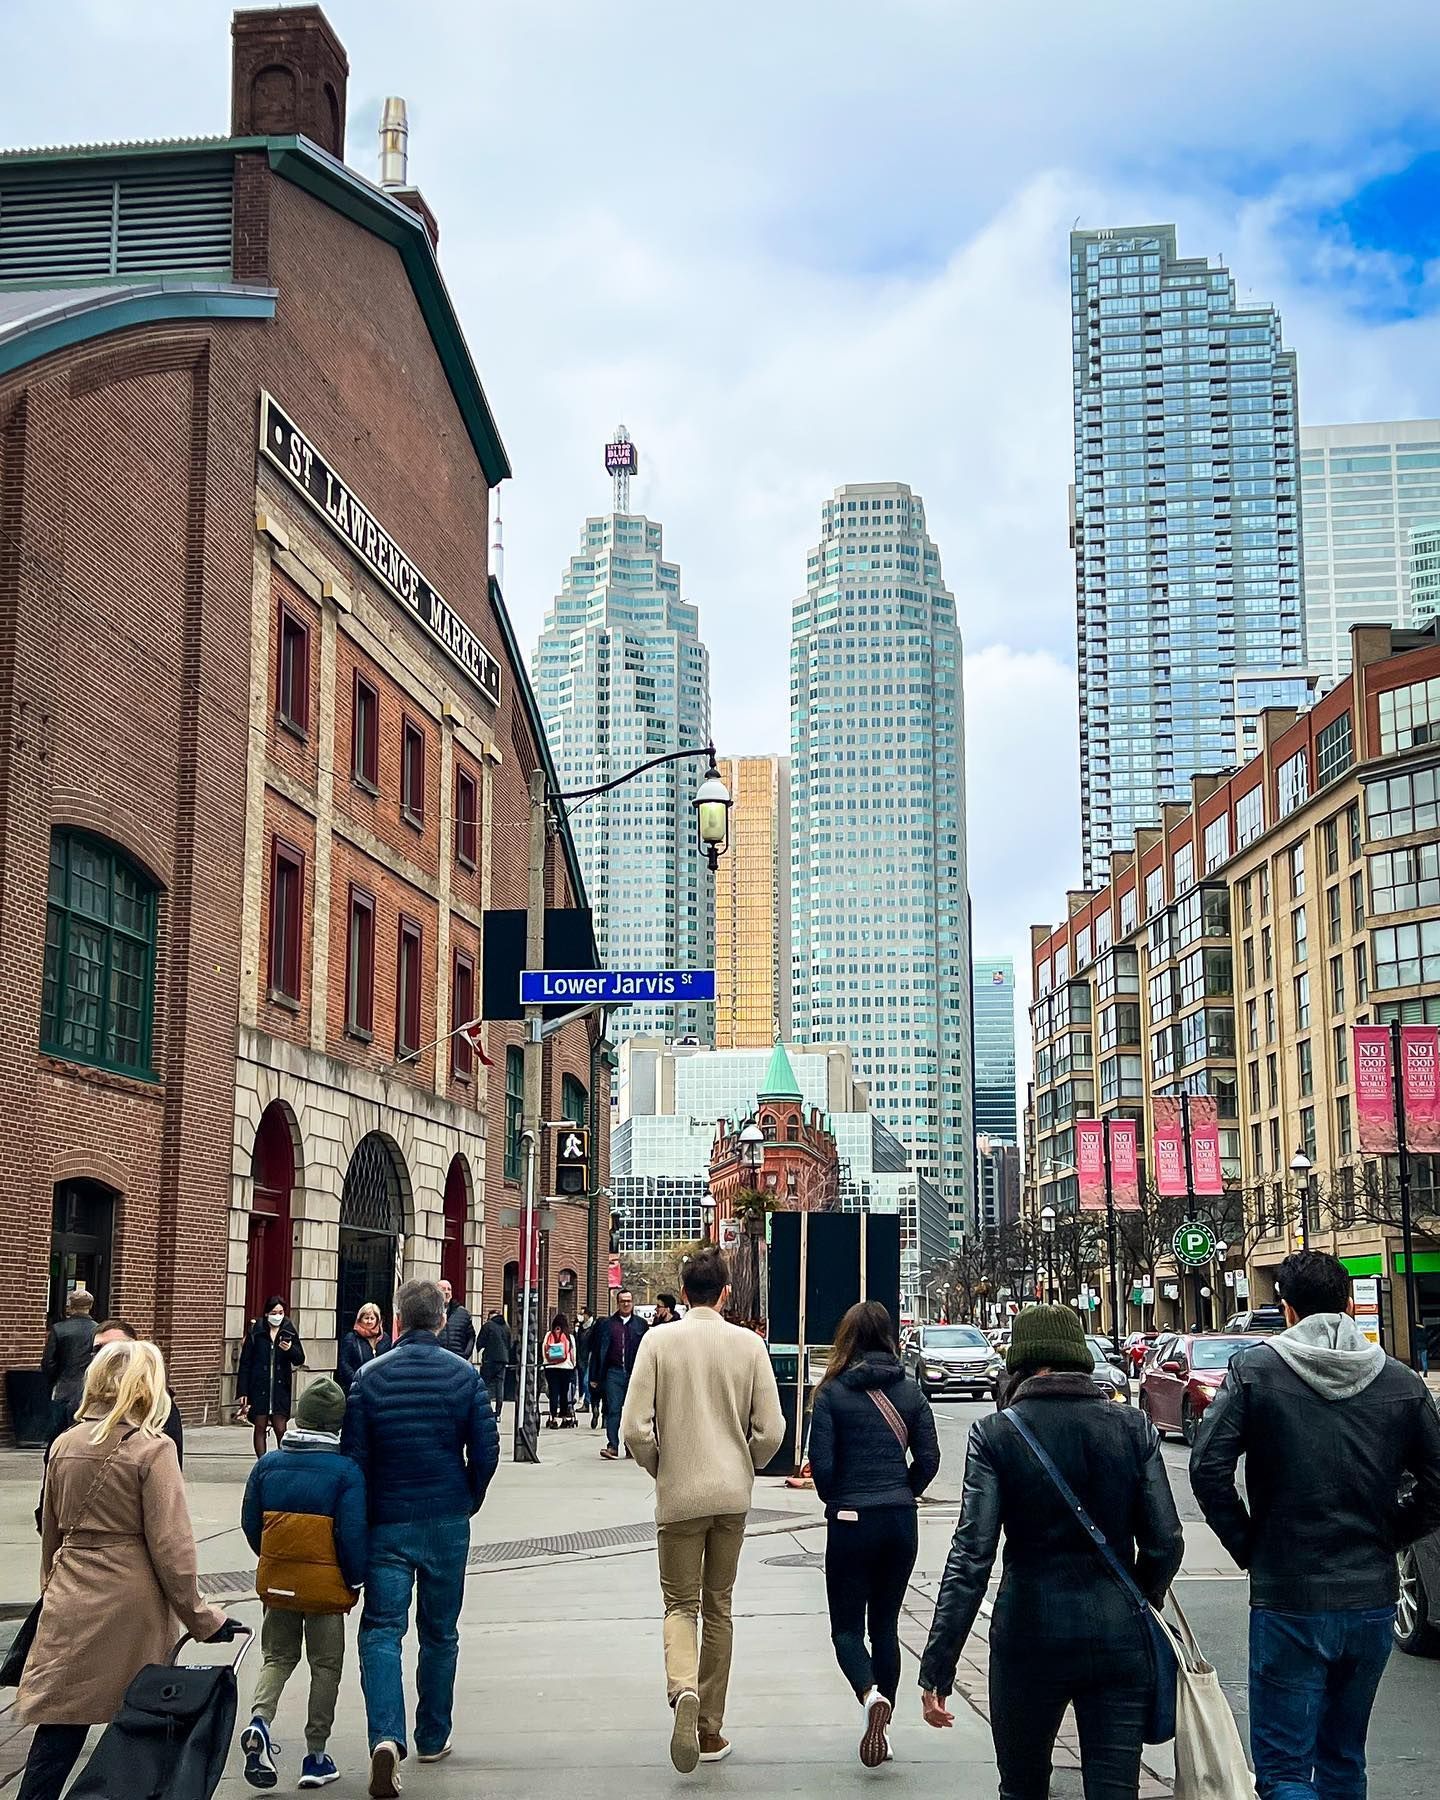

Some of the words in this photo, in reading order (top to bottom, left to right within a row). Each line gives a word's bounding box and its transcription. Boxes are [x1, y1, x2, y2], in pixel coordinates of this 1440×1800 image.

[325, 471, 420, 610] LAWRENCE
[429, 591, 487, 685] MARKET
[543, 974, 606, 995] Lower
[612, 973, 675, 994] Jarvis
[681, 973, 693, 984] St
[1187, 1234, 1204, 1250] P
